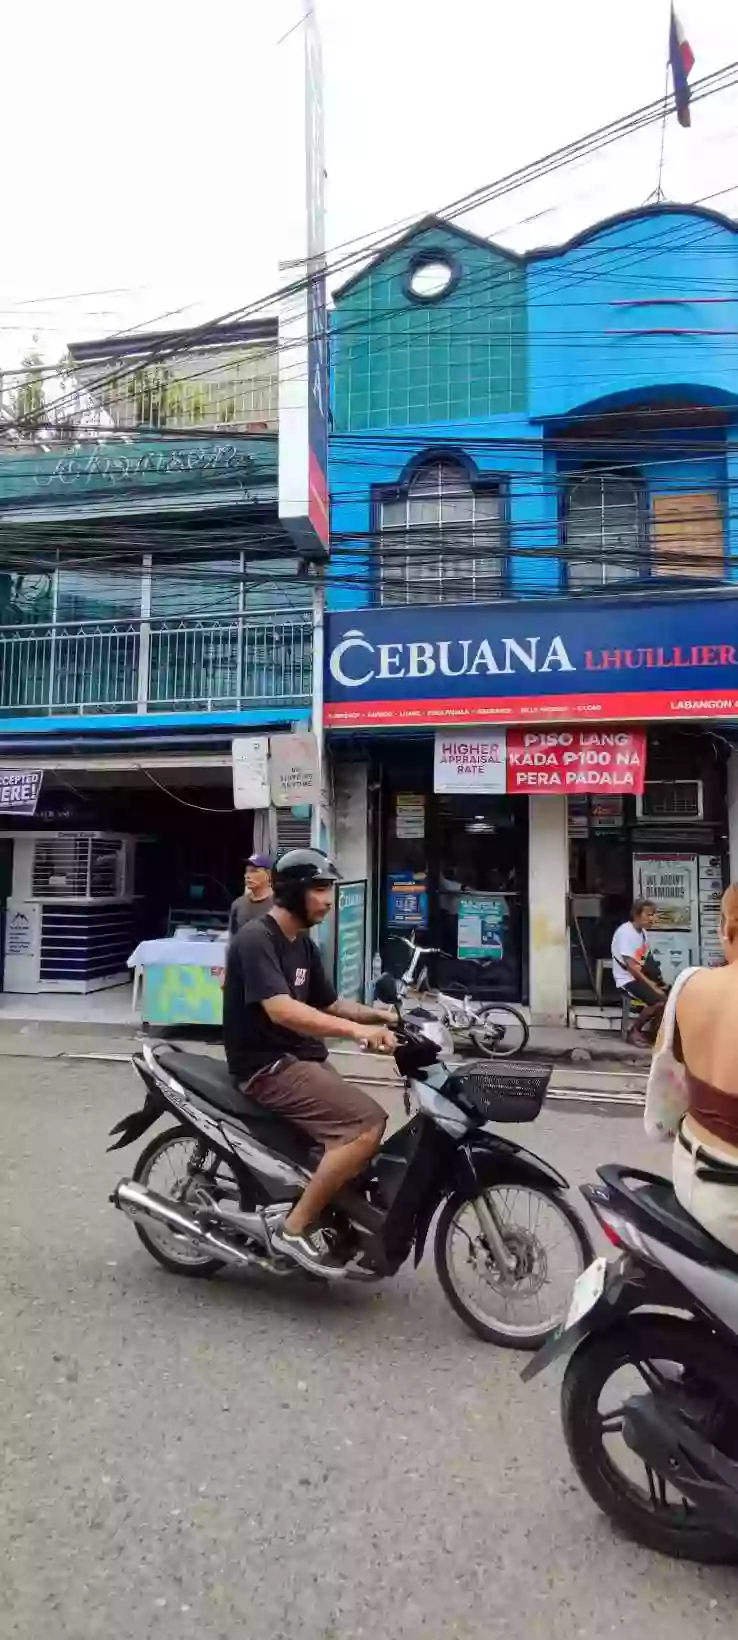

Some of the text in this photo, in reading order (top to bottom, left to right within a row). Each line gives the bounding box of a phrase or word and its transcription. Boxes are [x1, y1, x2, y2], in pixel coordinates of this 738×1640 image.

[330, 630, 738, 687] CEBUANA LHUILLIER
[670, 700, 733, 710] LABANGON
[580, 732, 629, 747] LANG
[442, 743, 500, 755] HIGHER
[439, 755, 503, 764] APPRAISAL
[509, 752, 559, 766] KADA
[616, 752, 641, 766] NA
[457, 765, 485, 774] RATE
[516, 771, 634, 785] PERA PADALA
